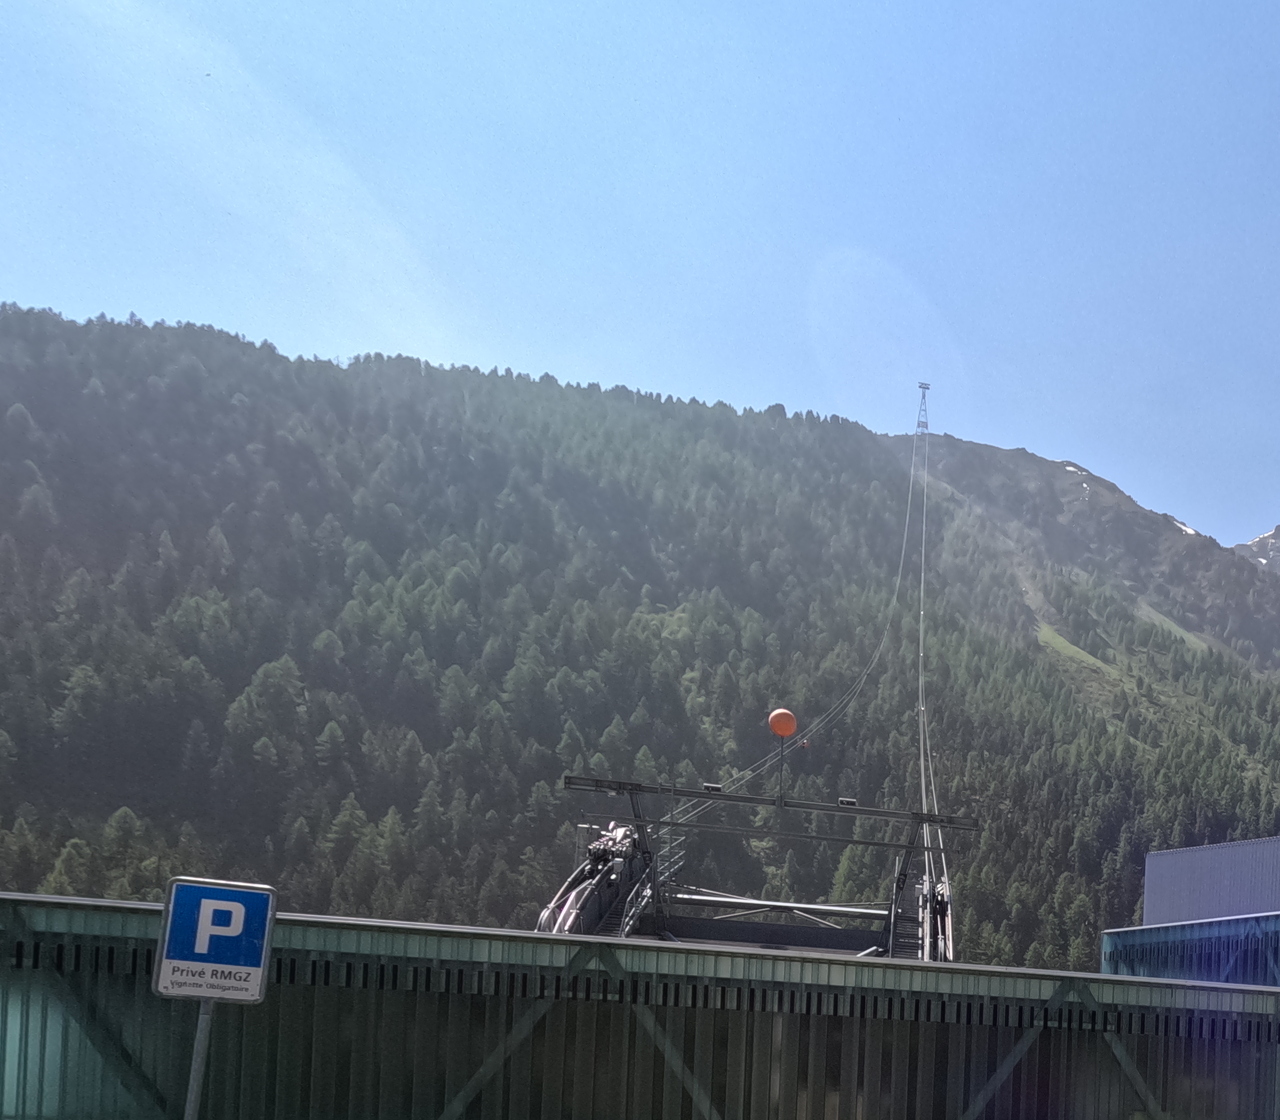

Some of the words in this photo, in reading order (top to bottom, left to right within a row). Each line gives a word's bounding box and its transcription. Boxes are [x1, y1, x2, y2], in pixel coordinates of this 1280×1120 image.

[194, 898, 245, 954] P
[171, 965, 206, 979] Privé
[210, 969, 252, 983] RMGZ
